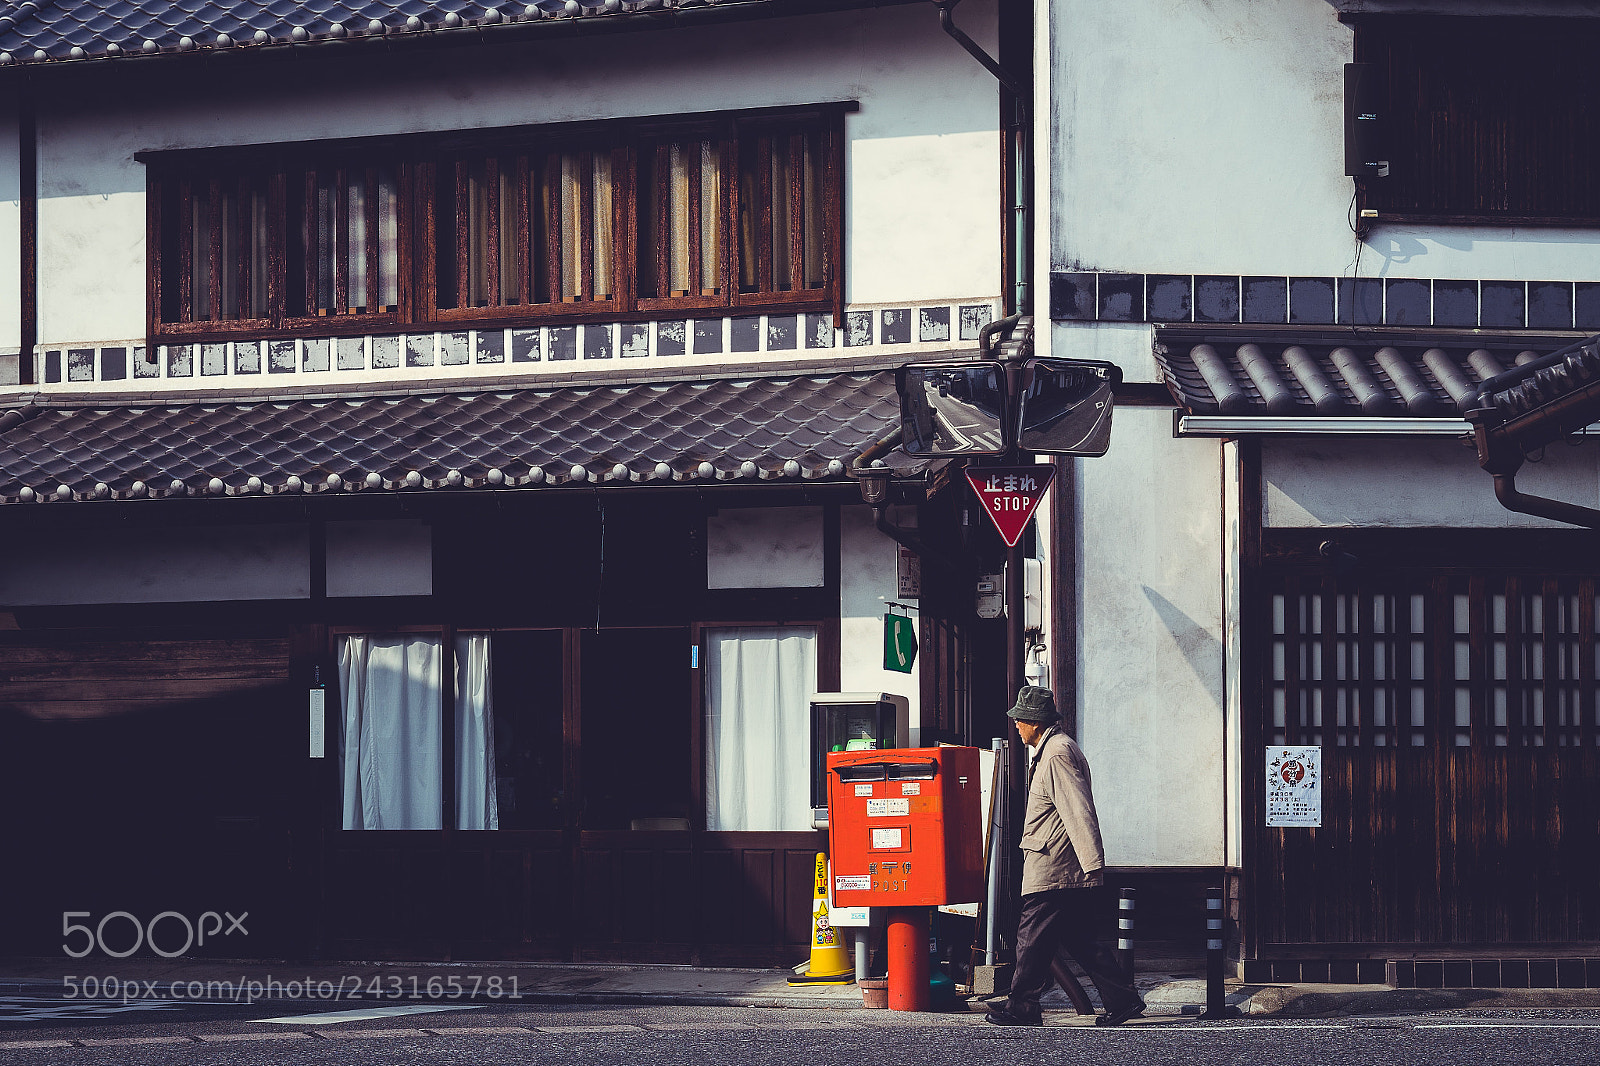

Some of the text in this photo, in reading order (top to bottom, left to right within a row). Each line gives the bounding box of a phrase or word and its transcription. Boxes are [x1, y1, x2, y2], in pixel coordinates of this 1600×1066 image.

[984, 474, 1038, 492] 止まれ
[993, 497, 1030, 511] STOP
[873, 879, 908, 892] POST
